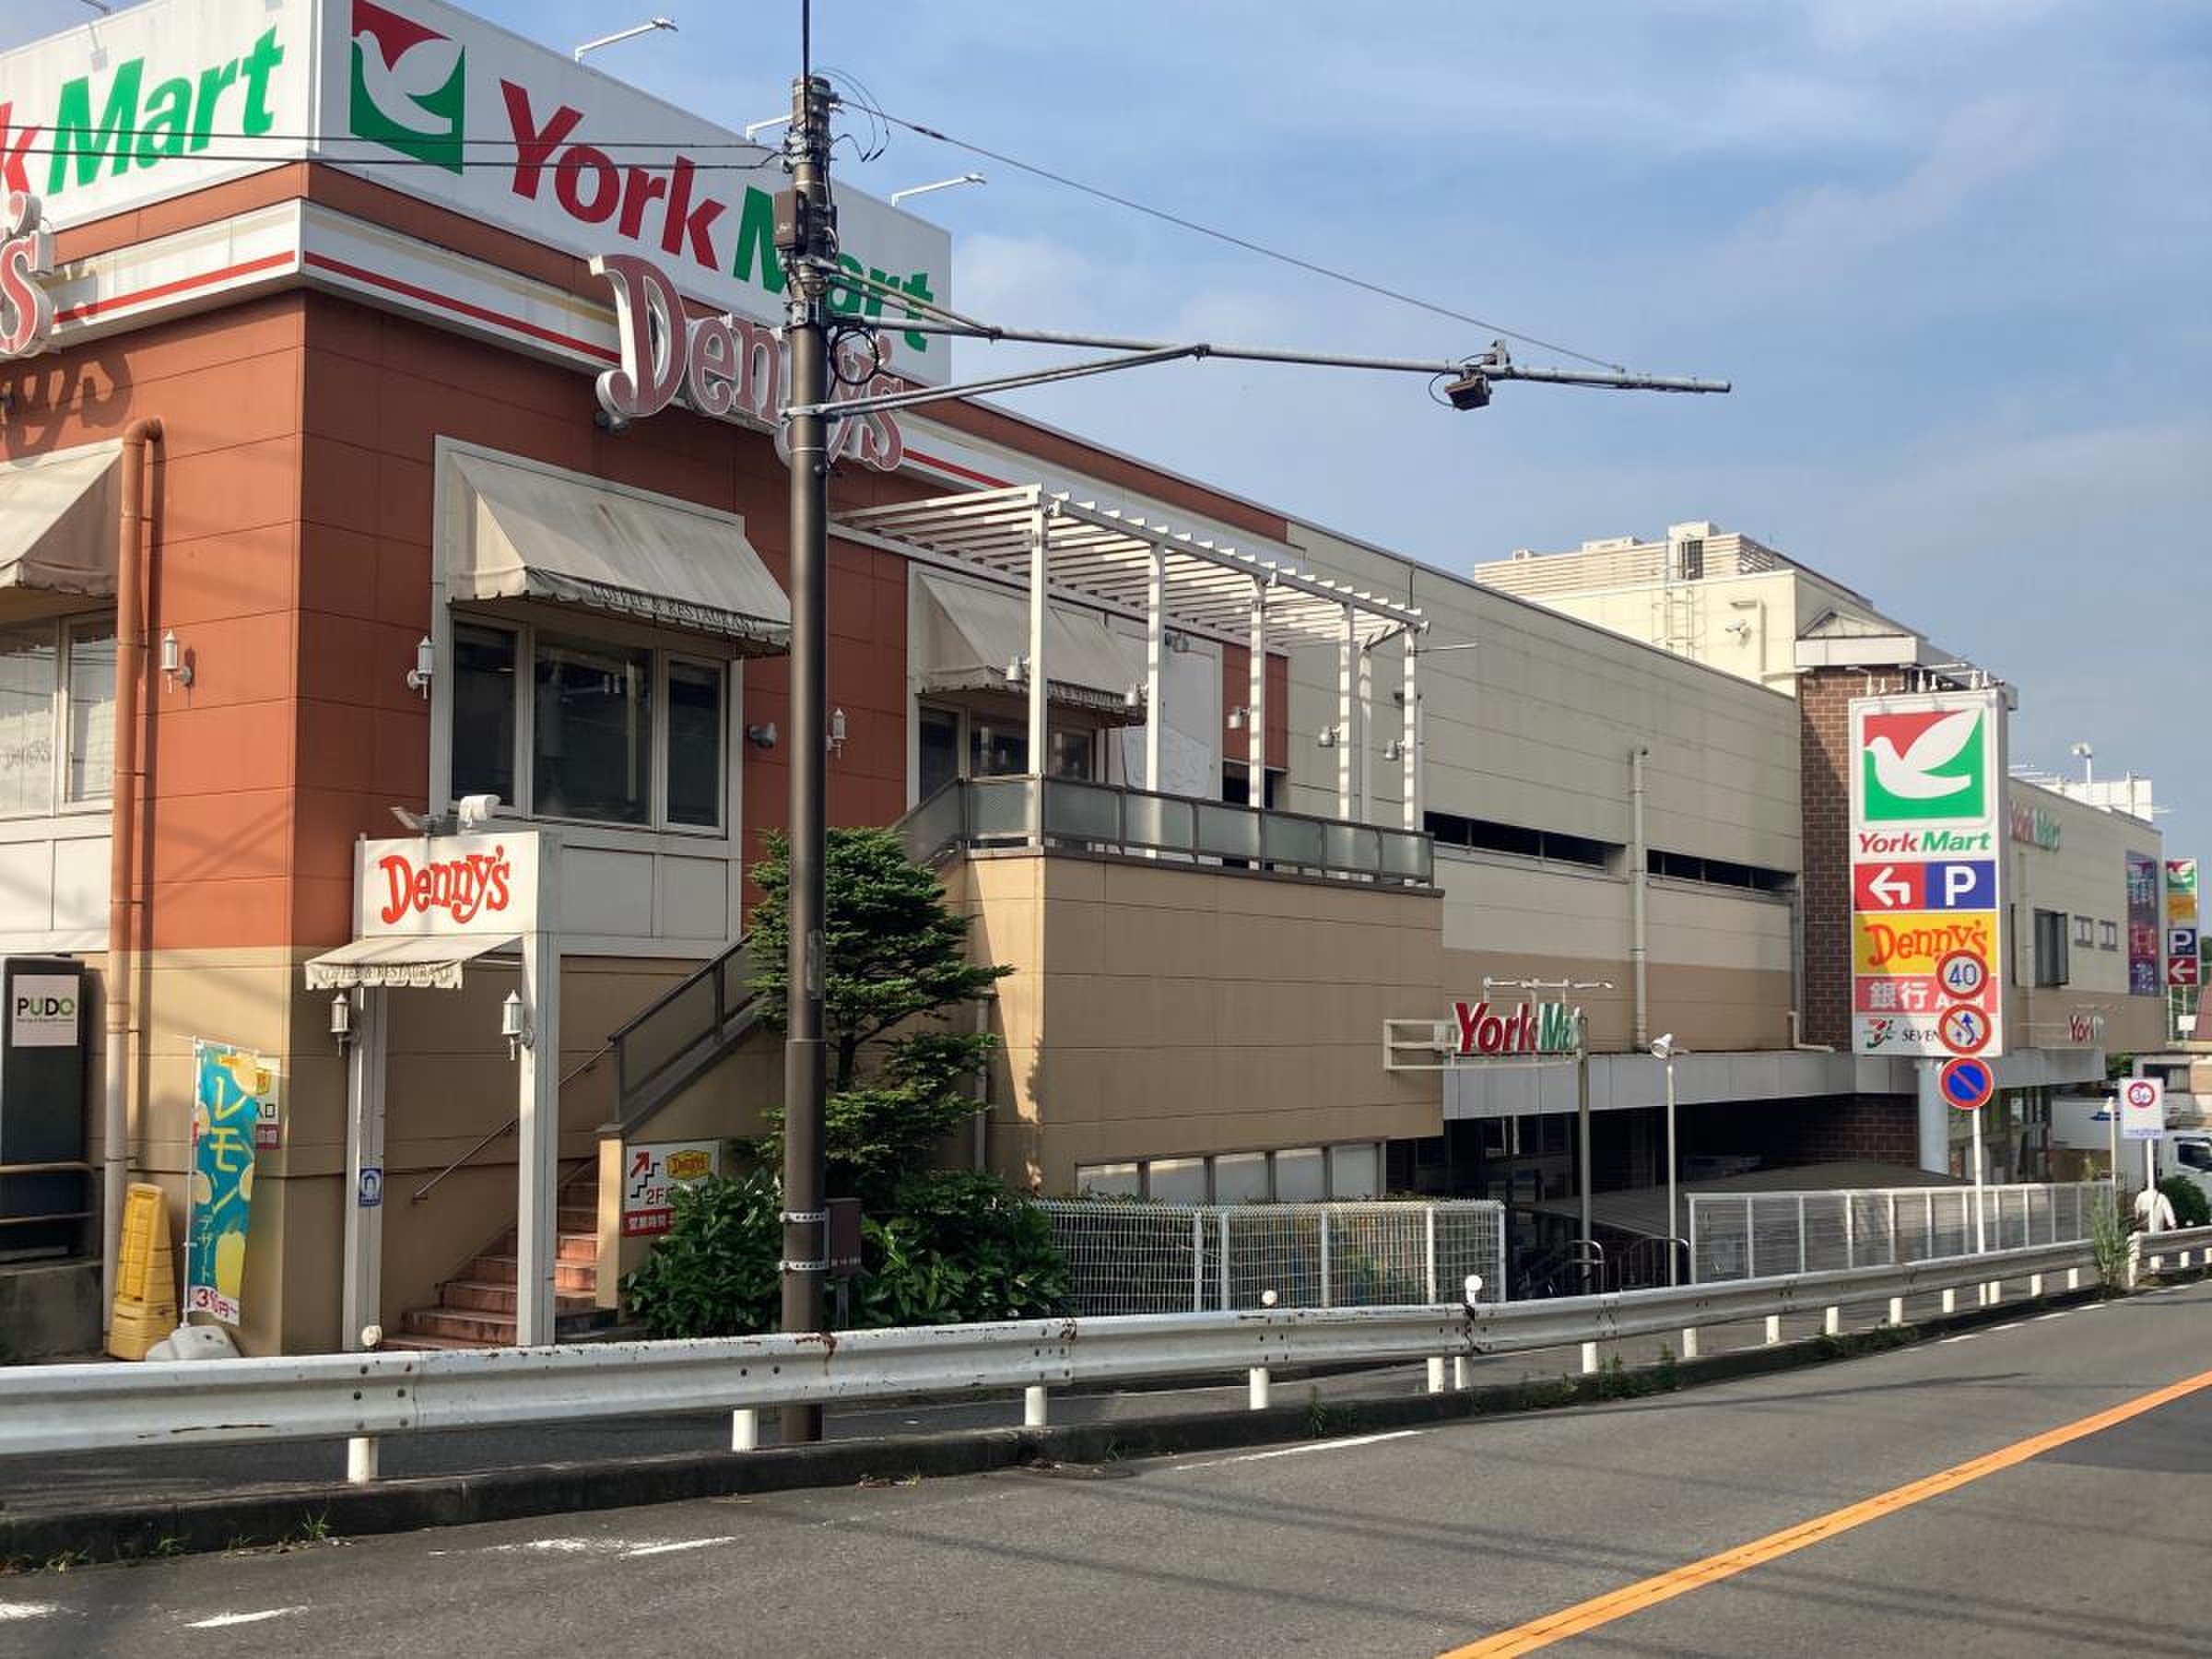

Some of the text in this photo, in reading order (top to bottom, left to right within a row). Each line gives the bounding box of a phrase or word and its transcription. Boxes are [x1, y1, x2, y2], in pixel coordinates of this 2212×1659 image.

[47, 23, 285, 195] Mart
[500, 78, 726, 272] York
[1859, 830, 1991, 853] York Mart
[380, 845, 511, 924] Denny's
[1946, 865, 1977, 907] P
[1864, 920, 1988, 967] Denny's
[2169, 930, 2193, 954] P
[1870, 981, 1929, 1010] 銀行
[1948, 964, 1977, 987] 40
[17, 997, 75, 1017] PUDO
[1455, 1002, 1537, 1053] York
[209, 1076, 248, 1214] レモン
[647, 1187, 664, 1205] 2F
